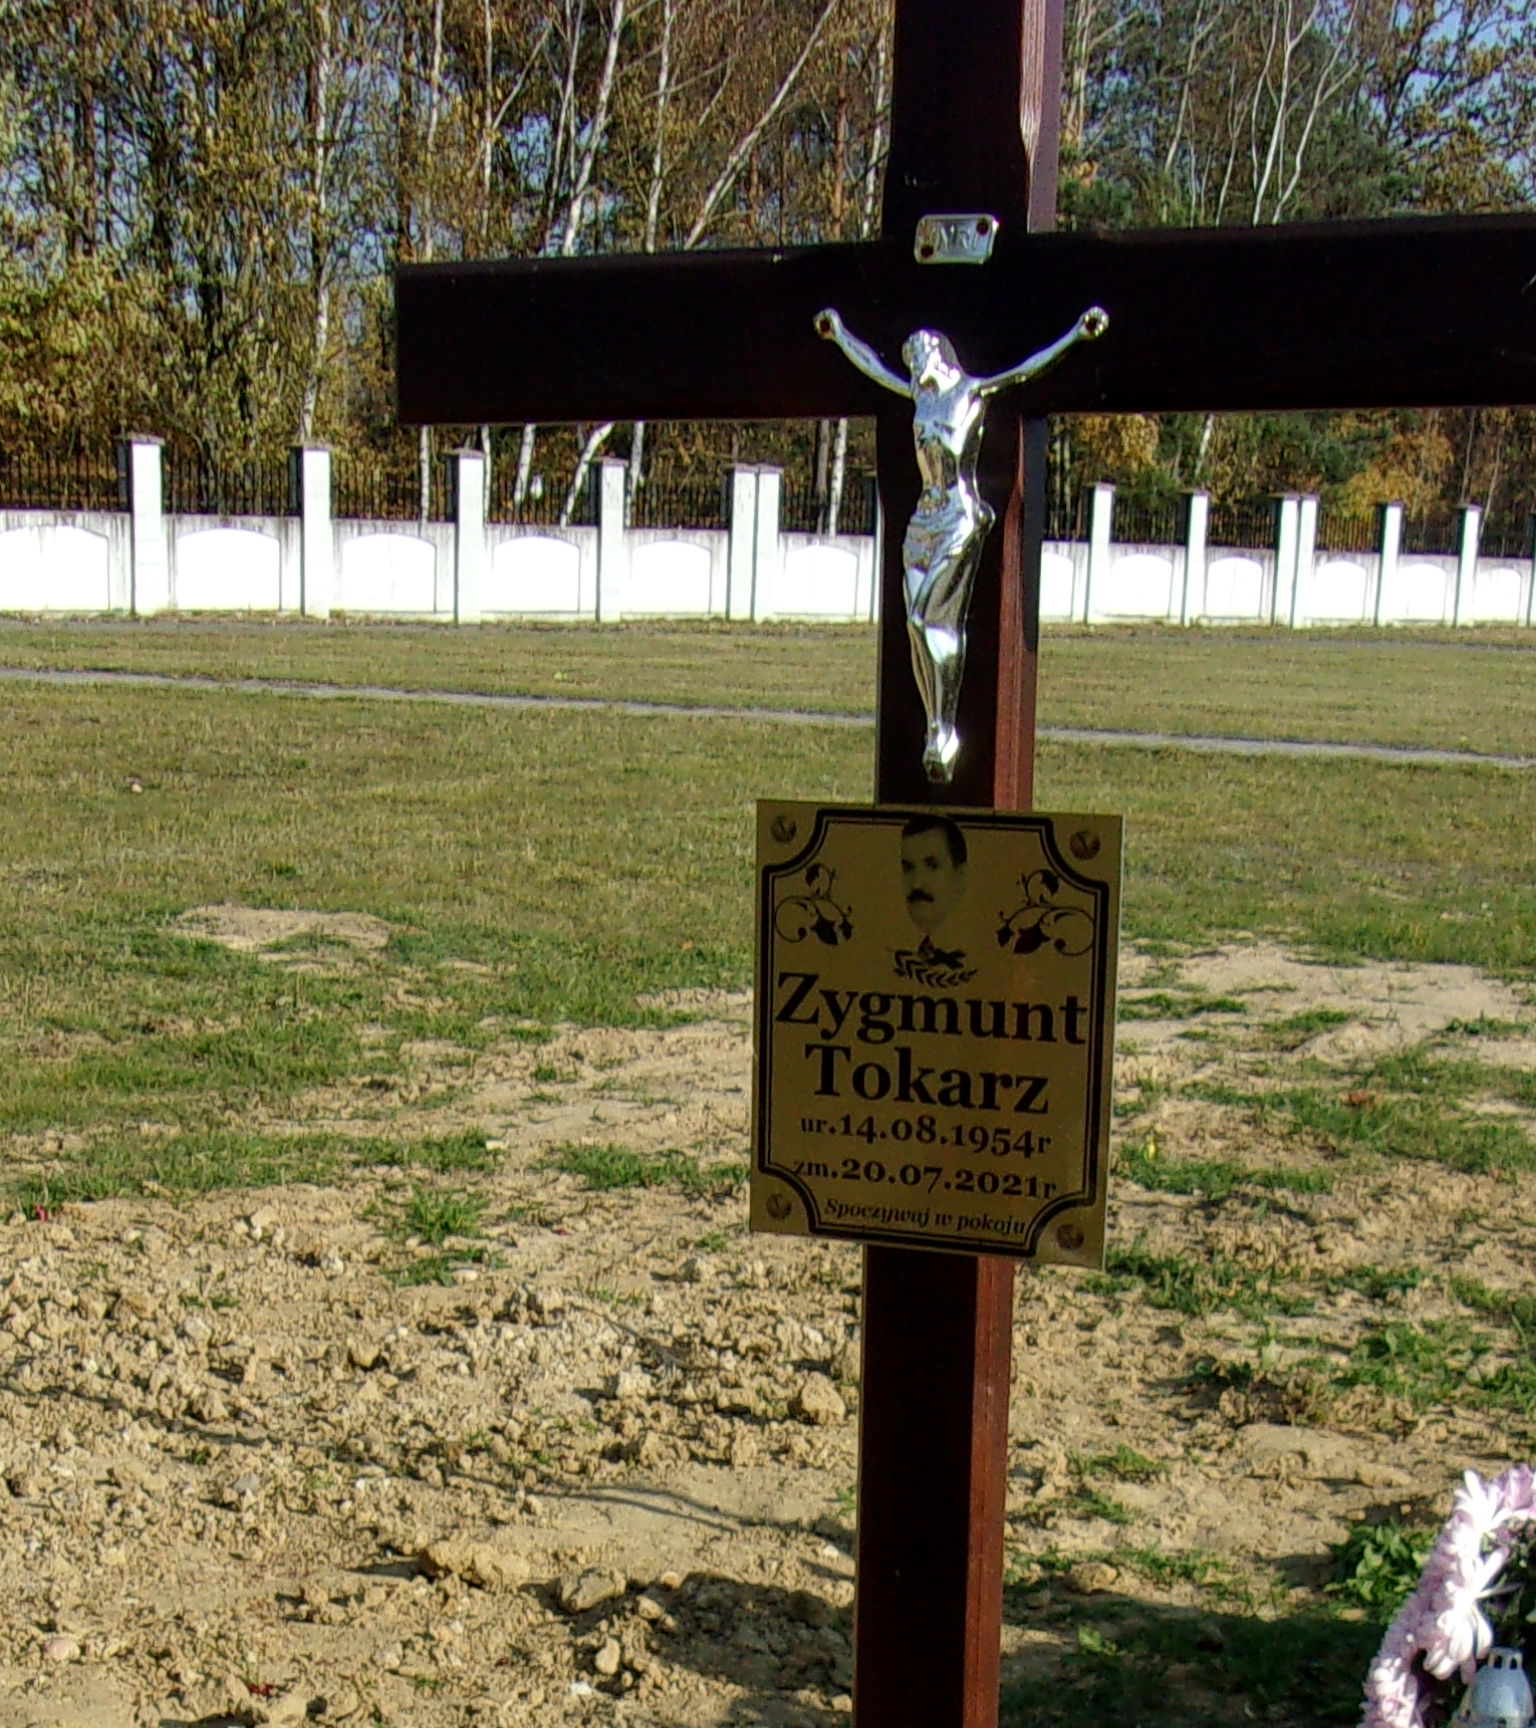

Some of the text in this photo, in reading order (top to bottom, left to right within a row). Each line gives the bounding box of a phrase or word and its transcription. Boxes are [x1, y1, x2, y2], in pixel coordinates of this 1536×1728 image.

[775, 971, 1088, 1045] Zygmunt
[804, 1043, 1050, 1115] Tokarz
[824, 1198, 1026, 1235] Spoczywaj w pokoju
